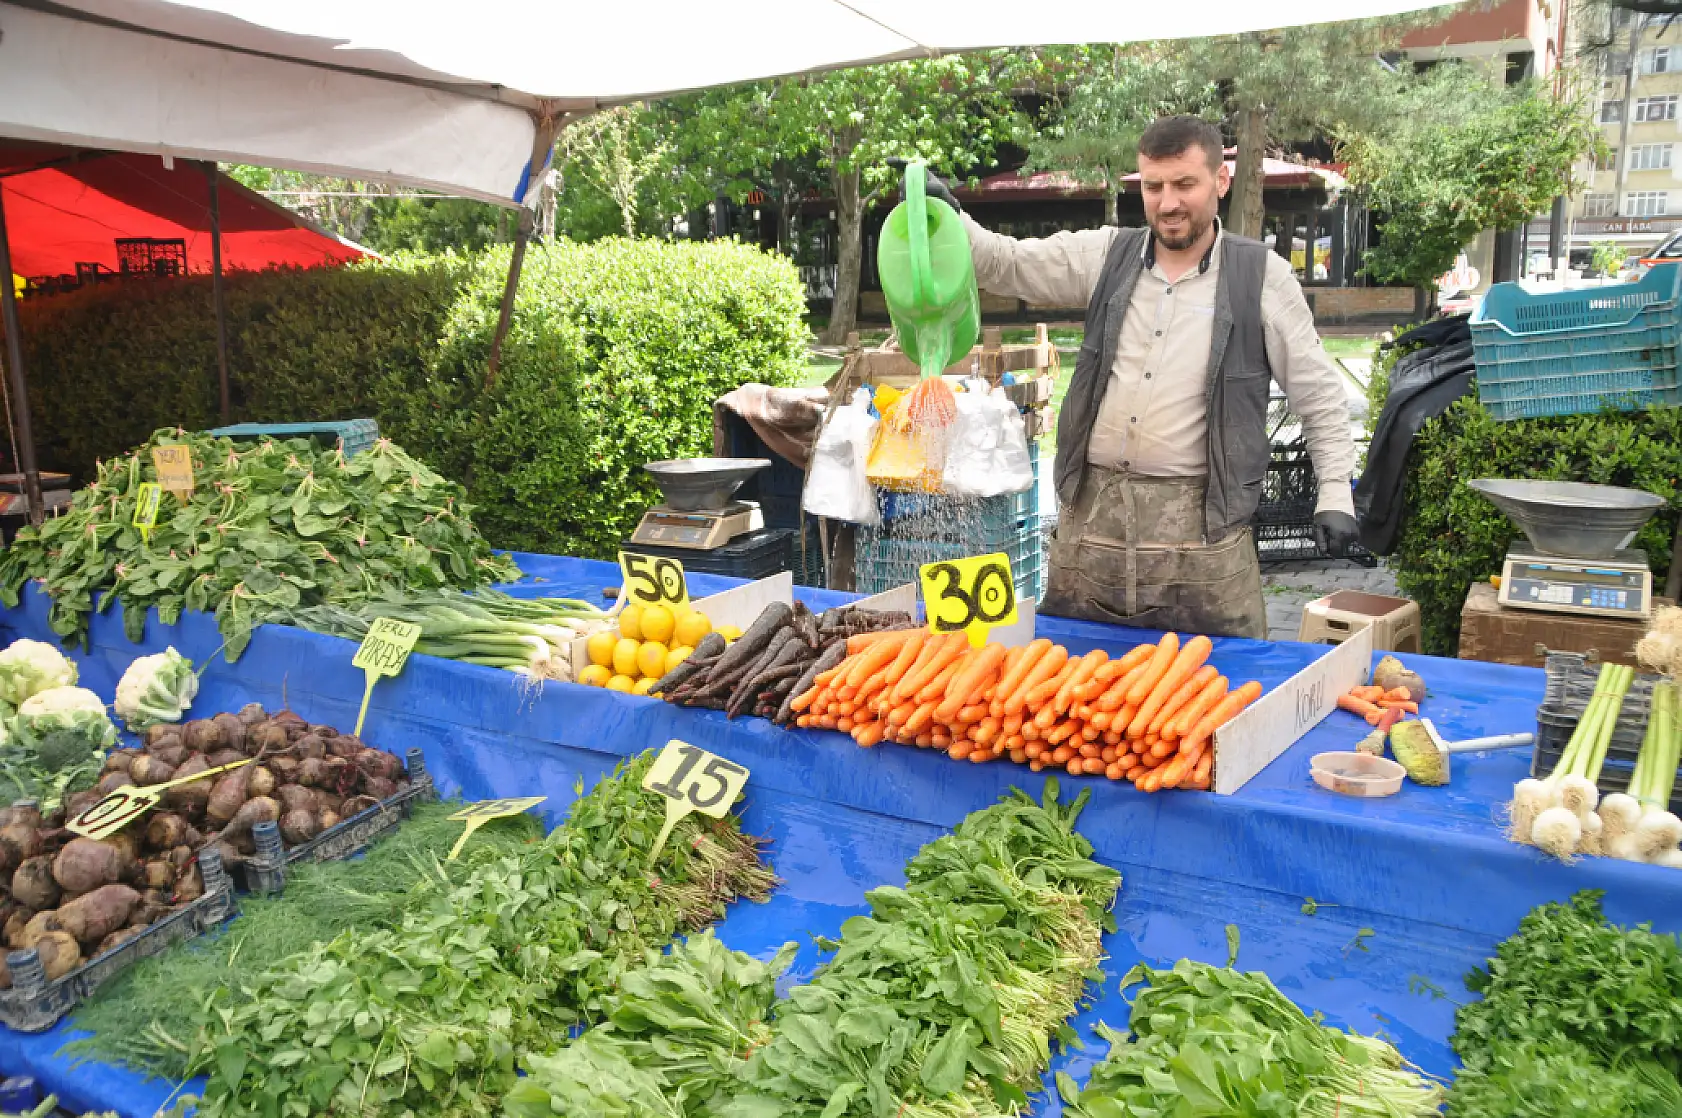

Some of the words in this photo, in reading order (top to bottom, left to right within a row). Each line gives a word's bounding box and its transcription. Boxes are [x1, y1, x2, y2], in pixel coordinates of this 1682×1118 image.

[624, 553, 685, 604] 50
[926, 563, 1016, 632] 30
[650, 745, 746, 808] 15
